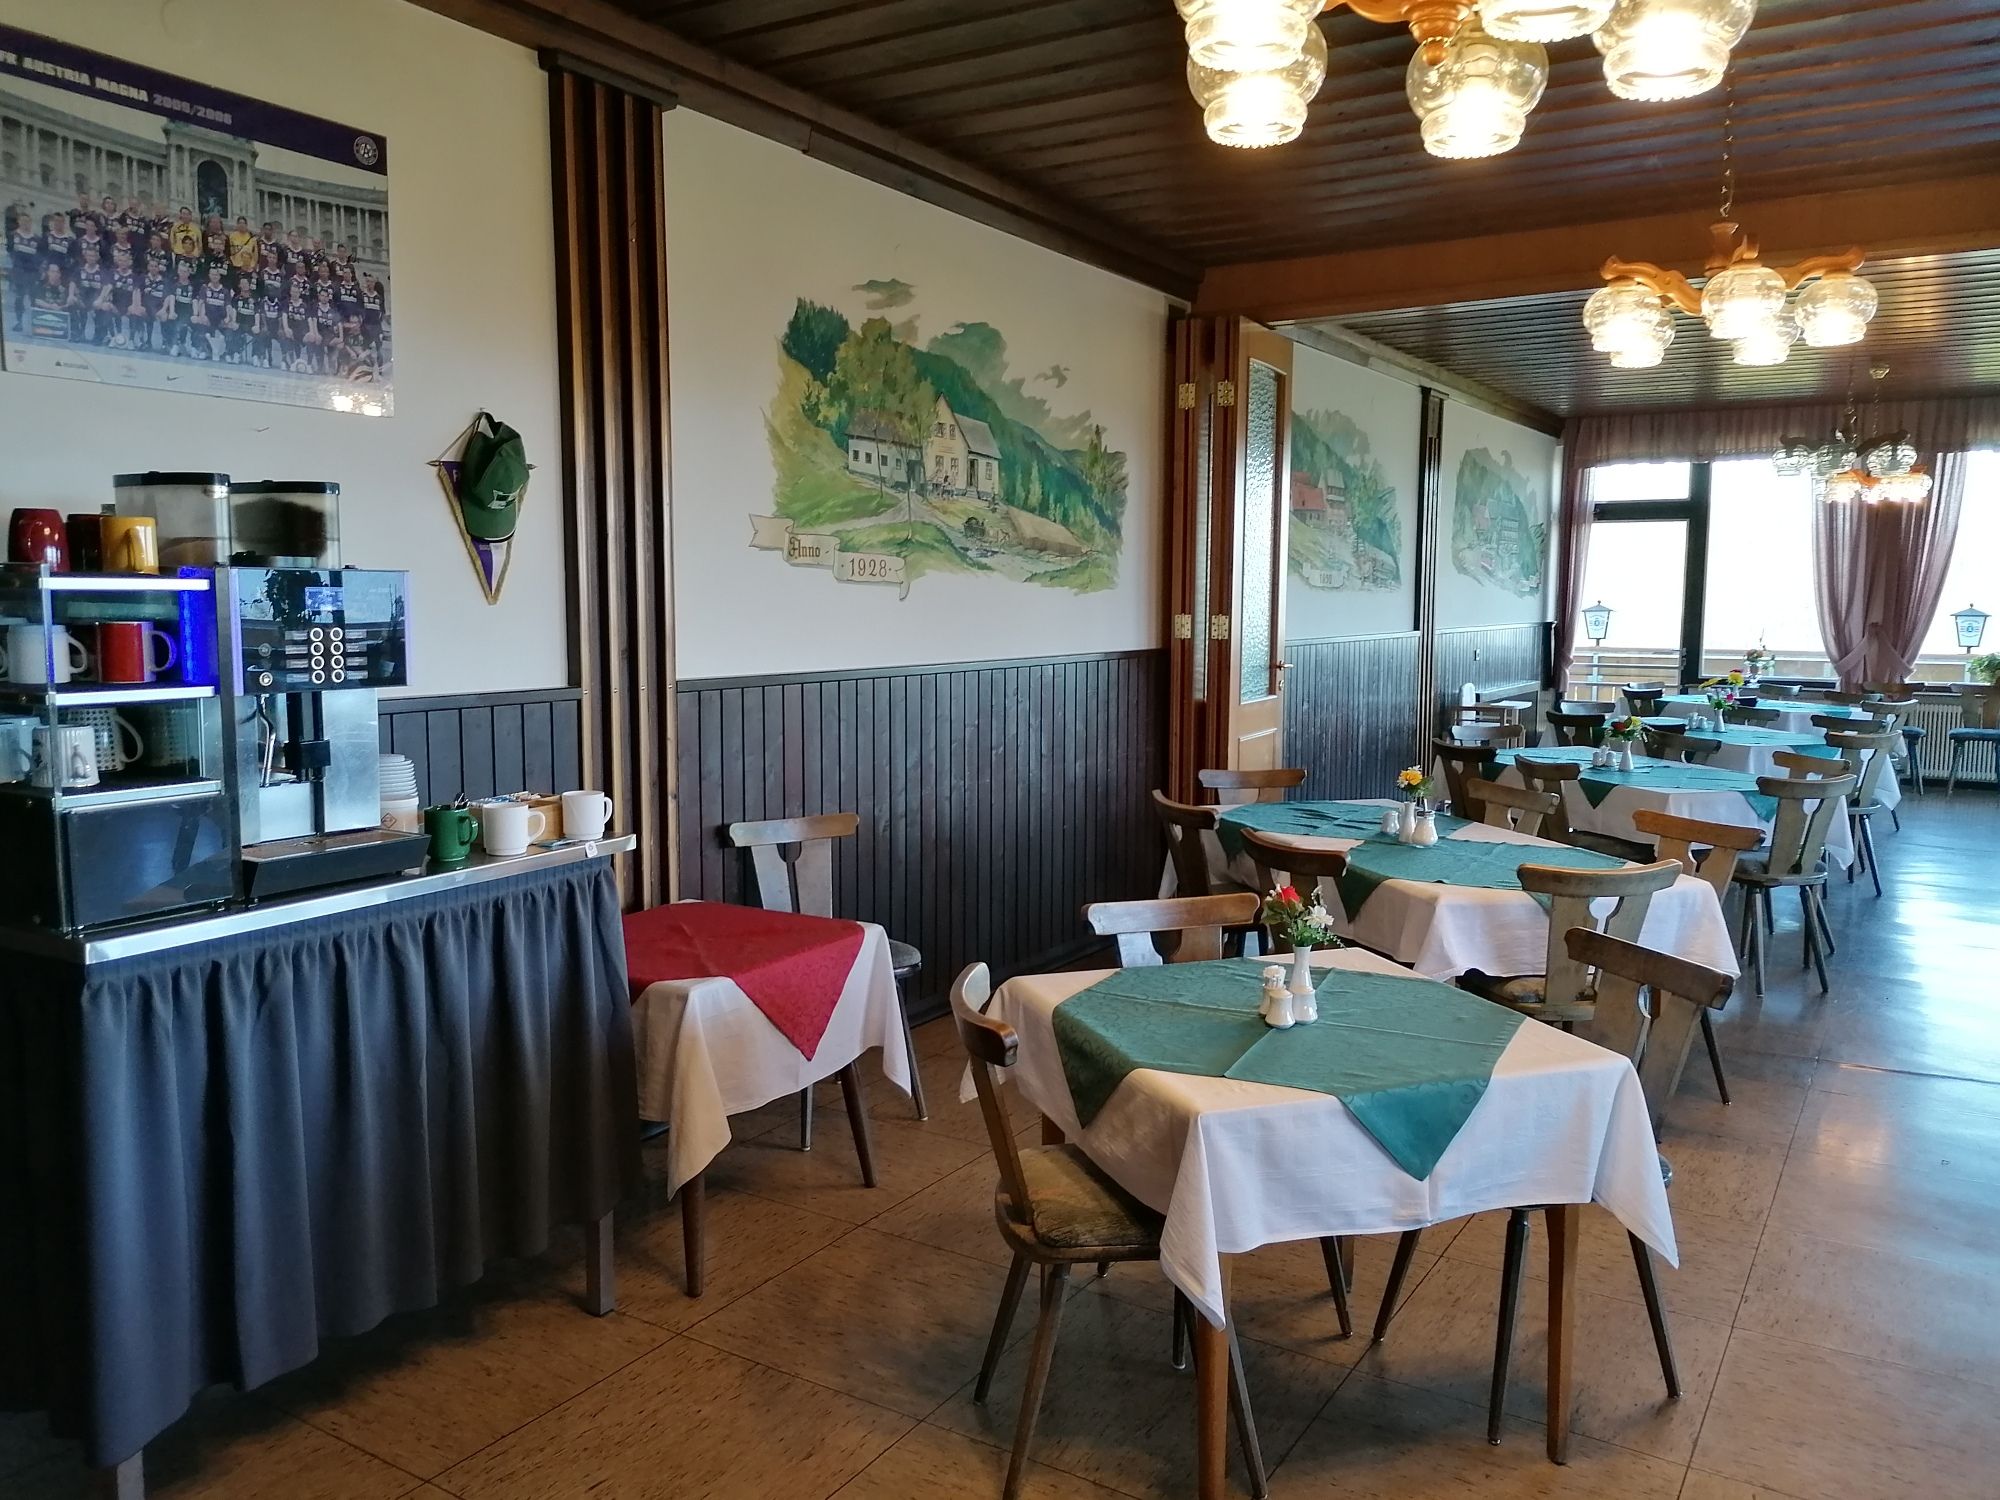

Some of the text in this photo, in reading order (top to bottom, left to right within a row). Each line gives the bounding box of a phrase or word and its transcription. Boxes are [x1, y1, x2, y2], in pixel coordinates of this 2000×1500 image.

[22, 57, 91, 87] AUSTRIA
[788, 536, 821, 560] Anno
[849, 558, 888, 578] 1928
